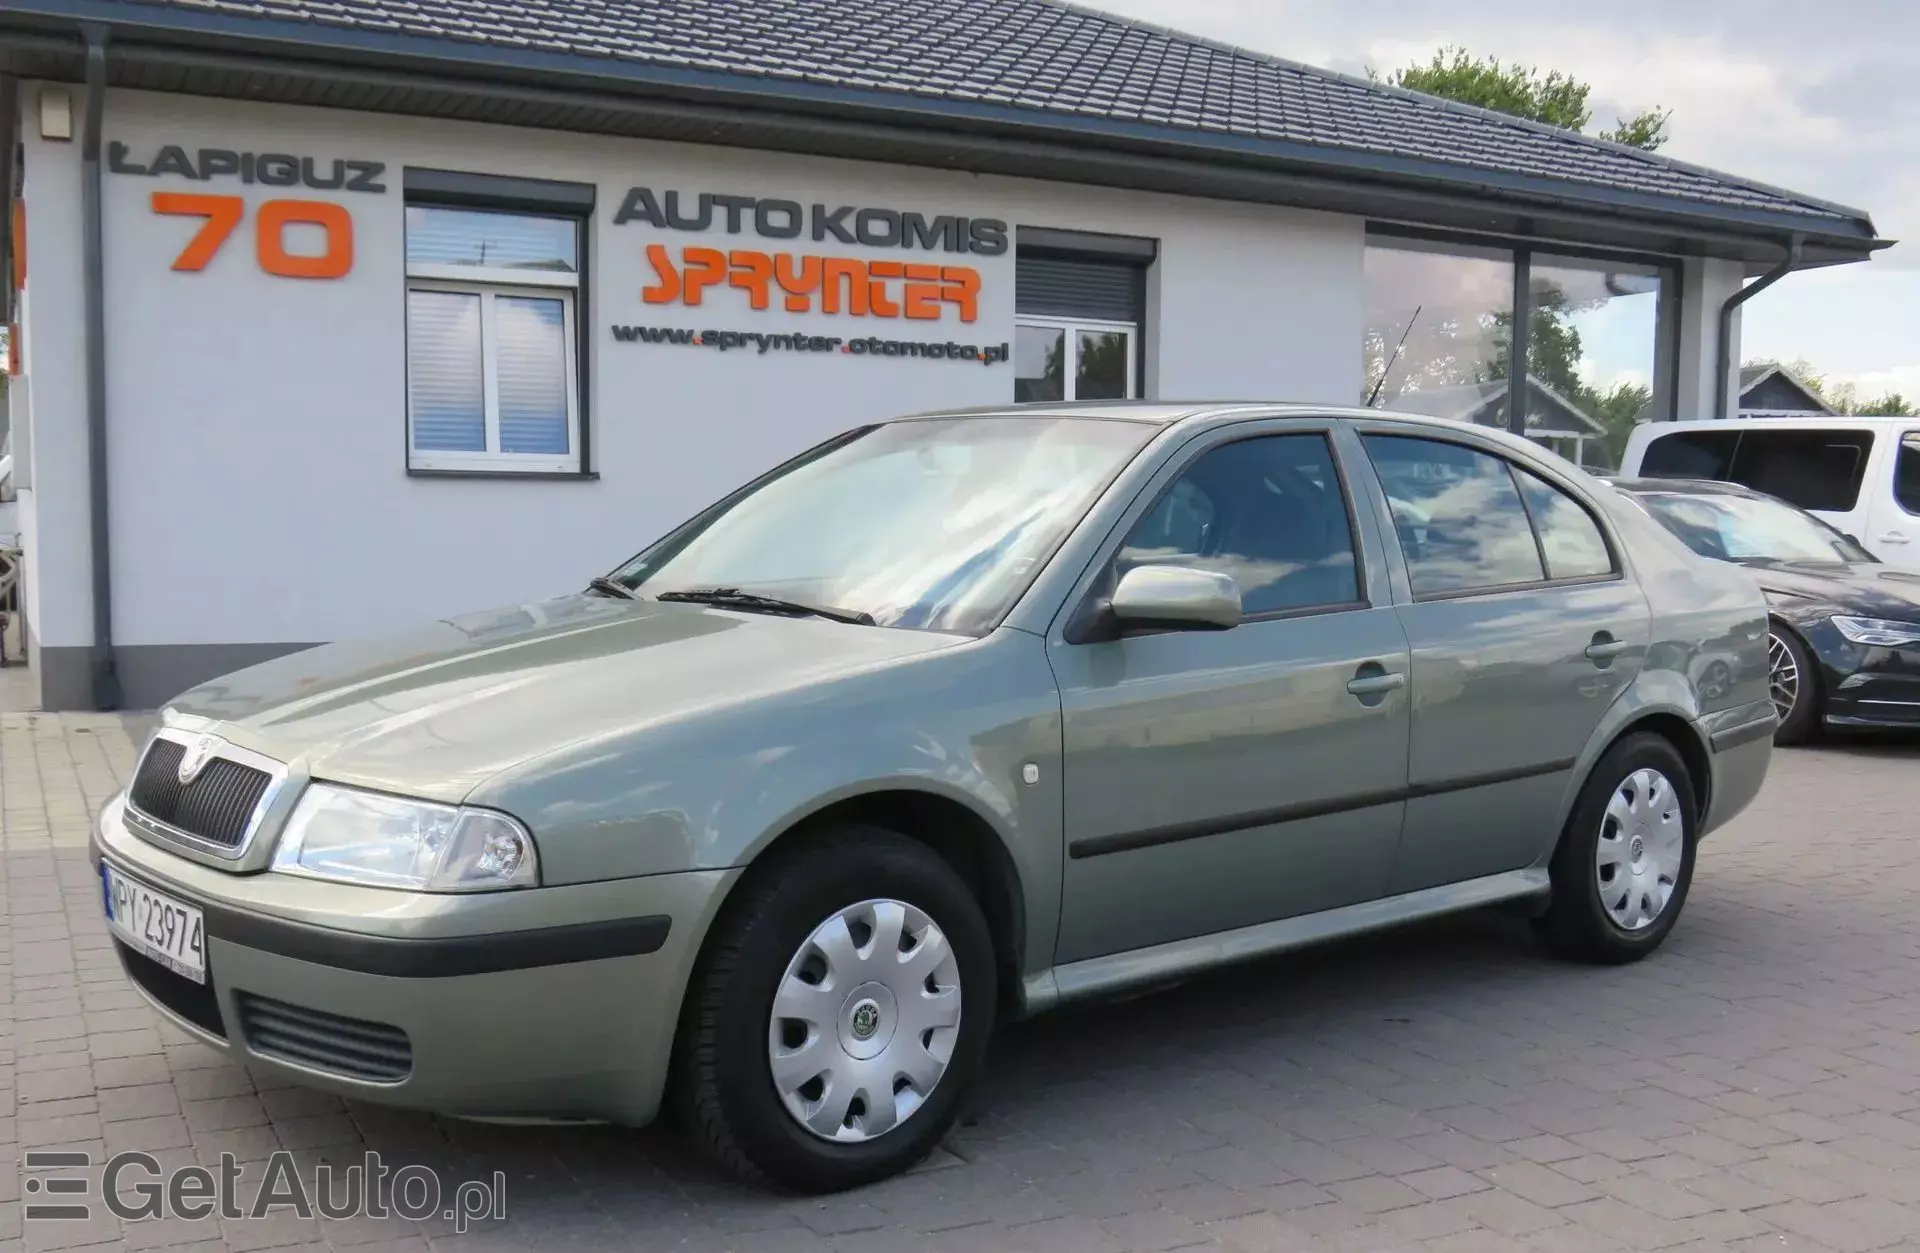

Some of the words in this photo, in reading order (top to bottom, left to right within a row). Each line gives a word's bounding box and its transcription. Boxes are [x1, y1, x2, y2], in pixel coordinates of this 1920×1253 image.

[108, 140, 386, 193] ŁAPIGUZ
[150, 191, 354, 280] 70
[613, 186, 802, 239] AUTO
[811, 203, 1009, 256] KOMIS
[642, 244, 982, 322] SPRYNTER
[611, 324, 1009, 366] www.sprynter.otomoto.pl
[143, 893, 203, 966] 23974
